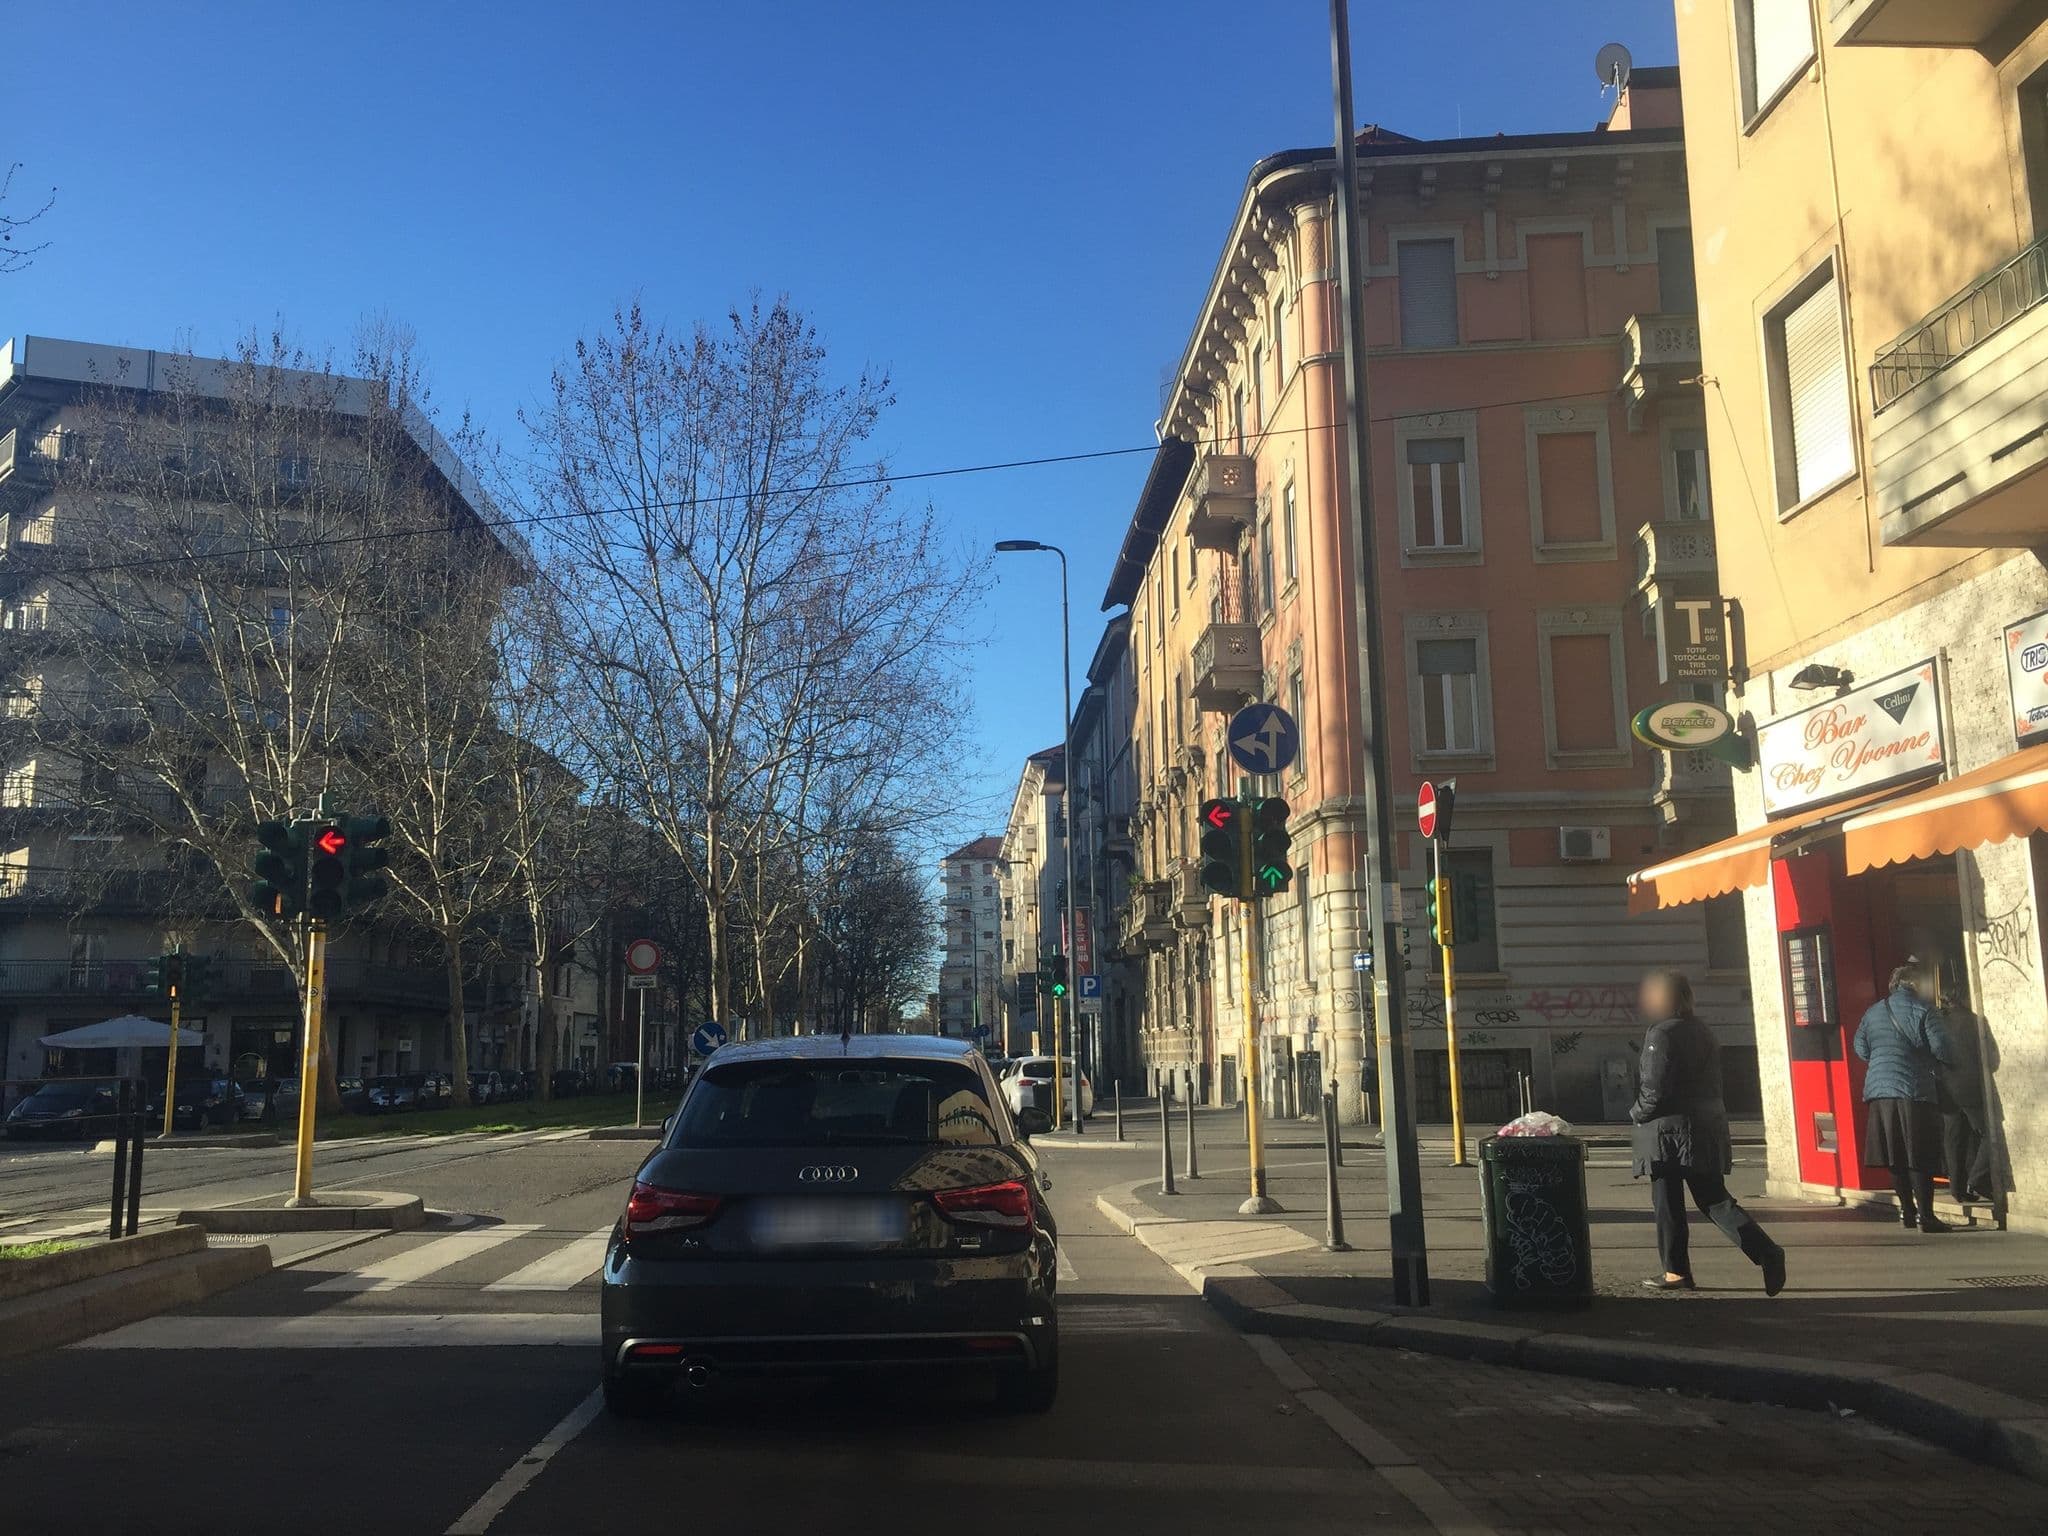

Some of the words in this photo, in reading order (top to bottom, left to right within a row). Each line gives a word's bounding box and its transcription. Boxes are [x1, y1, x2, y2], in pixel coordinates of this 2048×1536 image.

[1675, 601, 1711, 644] T
[2023, 647, 2047, 669] TRIS
[1662, 717, 1716, 729] BETTER
[1804, 704, 1867, 750] Bar
[1770, 762, 1826, 794] Chez
[1831, 731, 1931, 781] Yvonne
[1084, 978, 1096, 995] P
